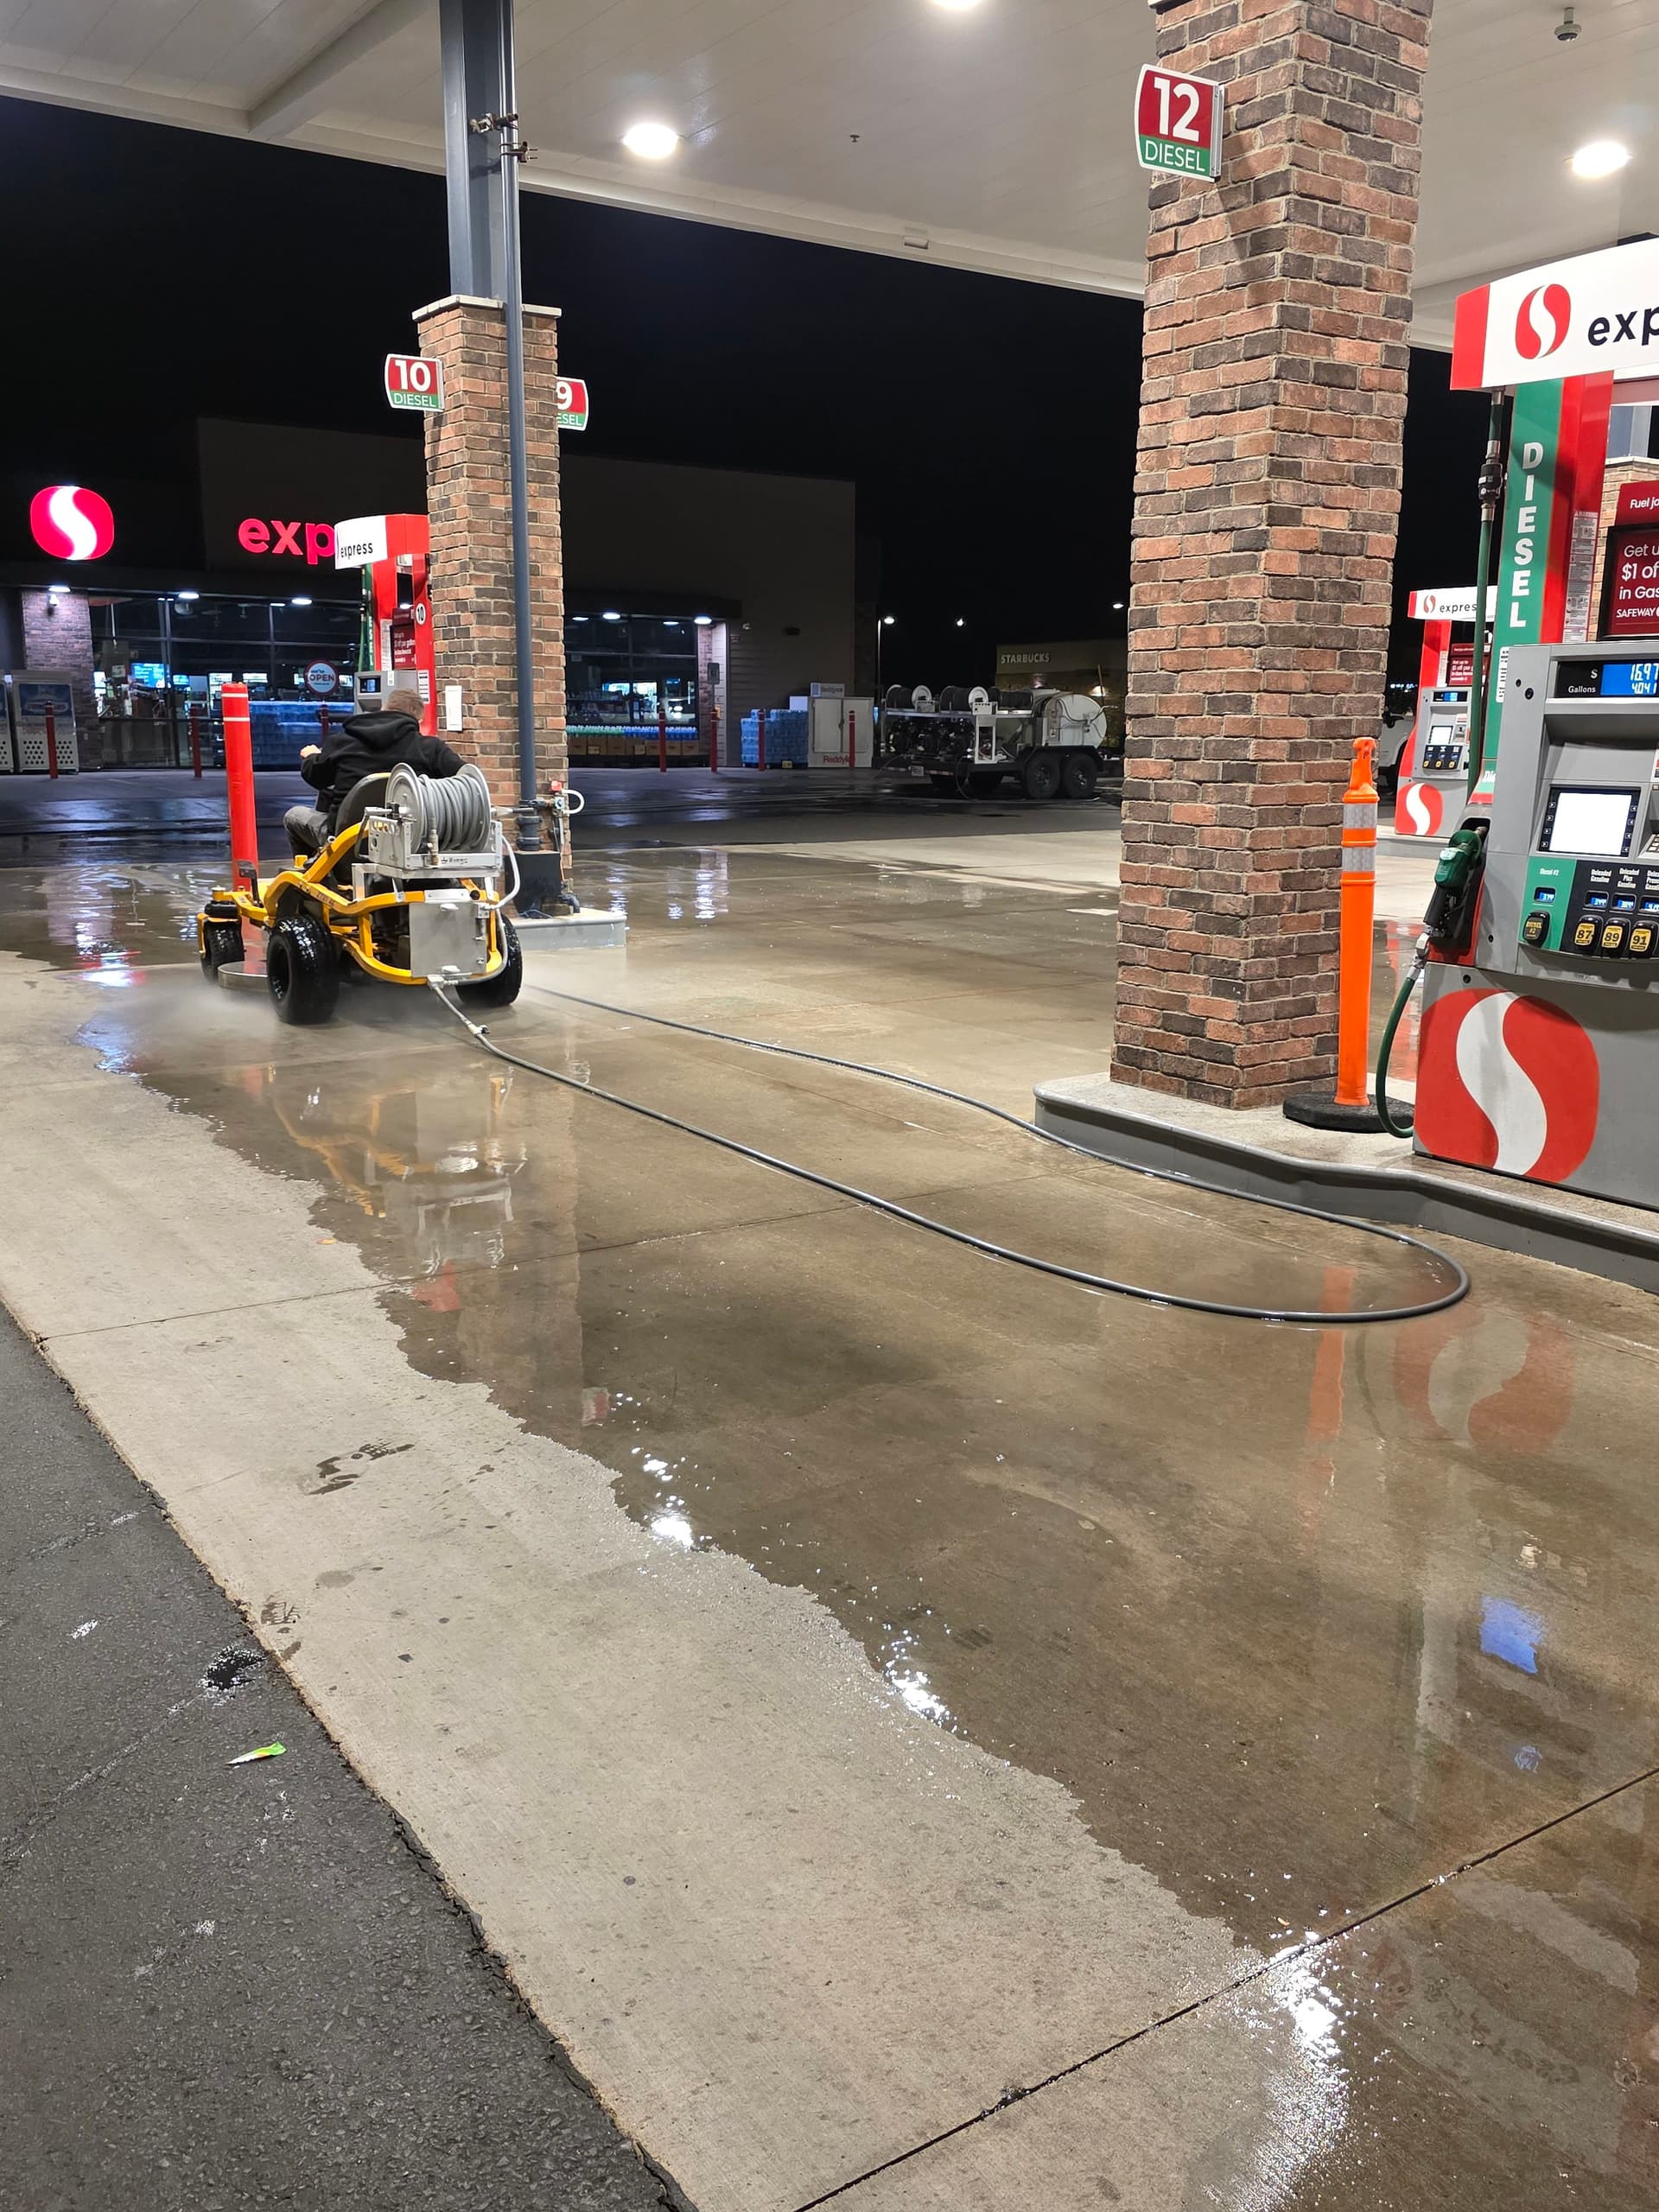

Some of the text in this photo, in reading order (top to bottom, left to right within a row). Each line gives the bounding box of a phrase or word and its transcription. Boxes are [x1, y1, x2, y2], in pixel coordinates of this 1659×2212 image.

[1154, 76, 1200, 143] 12
[1145, 139, 1206, 172] DIESEL
[1588, 306, 1659, 346] exp
[395, 359, 431, 391] 10
[393, 392, 436, 408] DIESEL
[556, 381, 573, 410] 9
[556, 412, 582, 426] ESEL
[1630, 497, 1649, 509] Fuel
[238, 518, 335, 565] exp
[1510, 442, 1544, 628] DIESEL
[340, 542, 373, 561] express
[1624, 544, 1649, 557] Get
[1621, 562, 1638, 582] $1
[1618, 586, 1631, 600] in
[417, 607, 423, 621] 10
[1440, 603, 1478, 613] expres
[1616, 607, 1656, 618] SAFEWAY
[1001, 652, 1051, 664] STARBUCKS
[1577, 930, 1592, 939] 87
[1604, 932, 1620, 942] 89
[1632, 935, 1647, 945] 91
